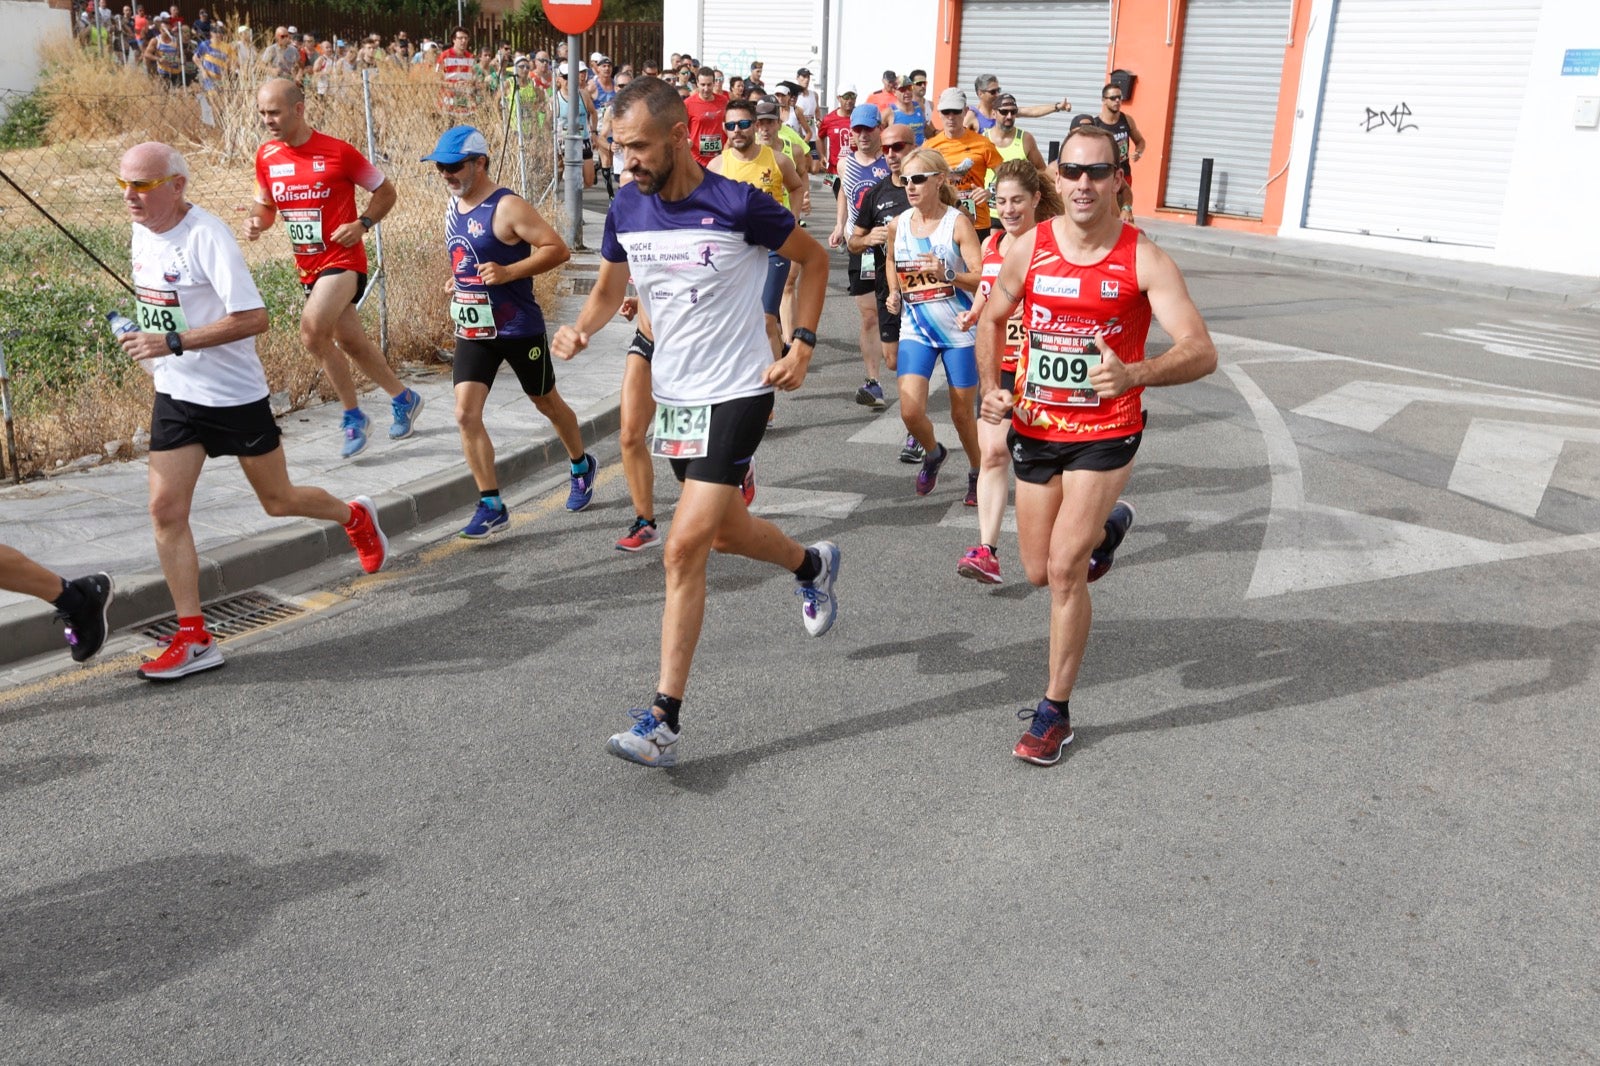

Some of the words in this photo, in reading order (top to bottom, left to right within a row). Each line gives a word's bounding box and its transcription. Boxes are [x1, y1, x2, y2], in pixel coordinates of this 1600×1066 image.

[704, 142, 719, 151] 552
[272, 182, 331, 203] Polisalud
[290, 224, 314, 240] 603
[630, 242, 652, 251] NOCHE
[639, 253, 657, 262] TRAIL
[659, 252, 690, 261] RUNNING
[142, 306, 177, 332] 848
[458, 307, 479, 324] 40
[1039, 354, 1088, 384] 609
